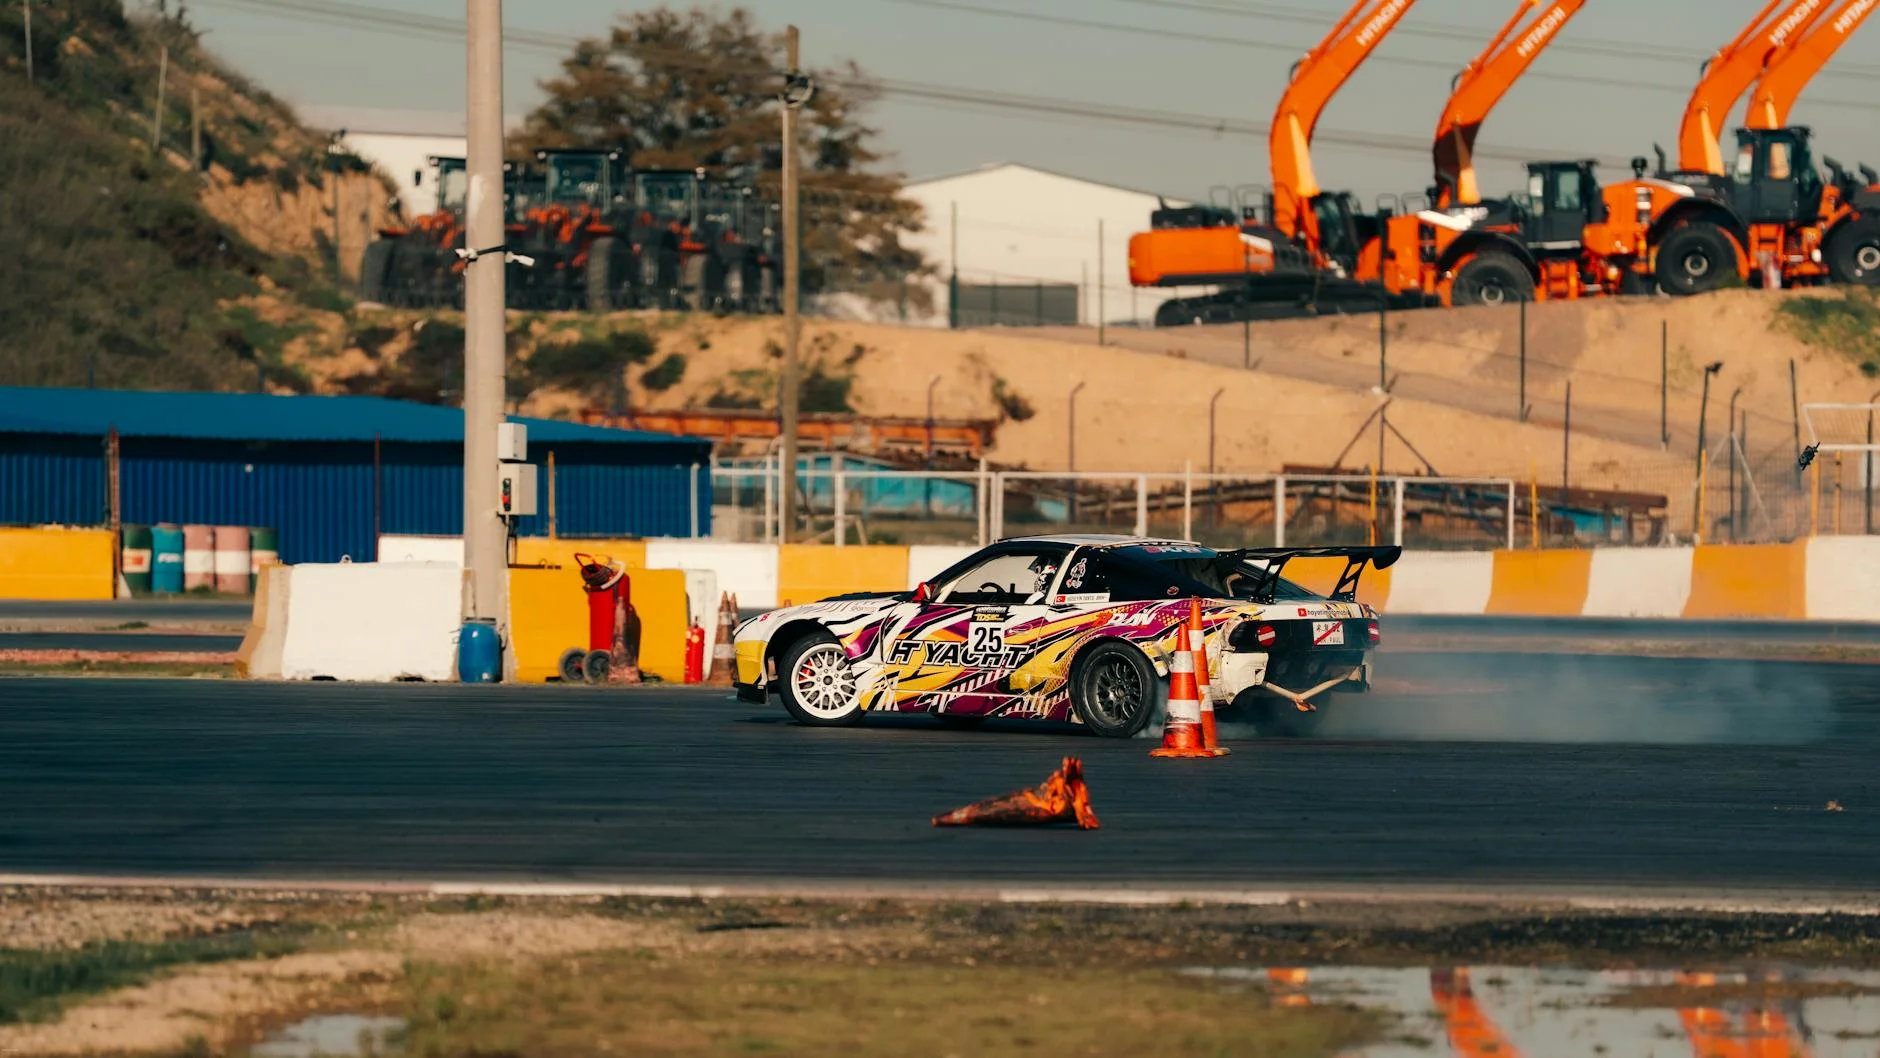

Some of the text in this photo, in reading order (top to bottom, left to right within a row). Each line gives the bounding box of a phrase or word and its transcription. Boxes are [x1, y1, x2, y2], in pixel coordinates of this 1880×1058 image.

[1516, 6, 1566, 58] HITACHI
[922, 640, 1028, 669] YACHT
[974, 627, 1003, 653] 25
